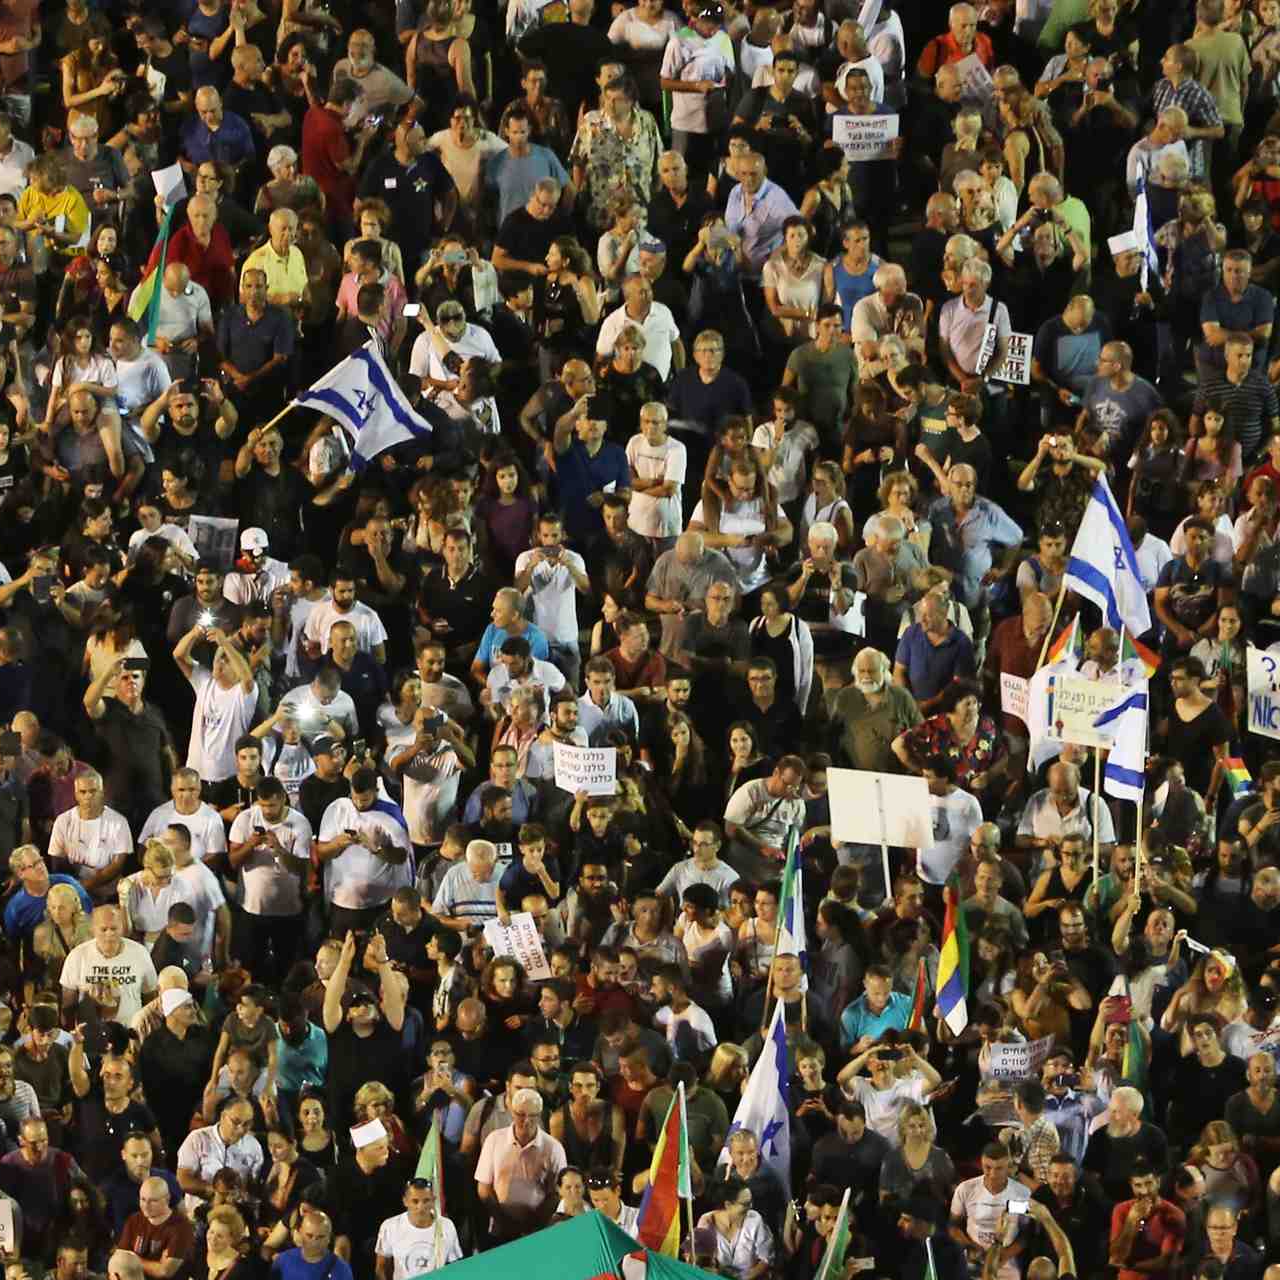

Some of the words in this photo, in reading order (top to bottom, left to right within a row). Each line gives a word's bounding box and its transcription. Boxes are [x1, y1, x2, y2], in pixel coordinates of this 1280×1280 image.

[93, 966, 110, 975] THE
[111, 966, 132, 975] GUY
[86, 976, 109, 985] NEXT
